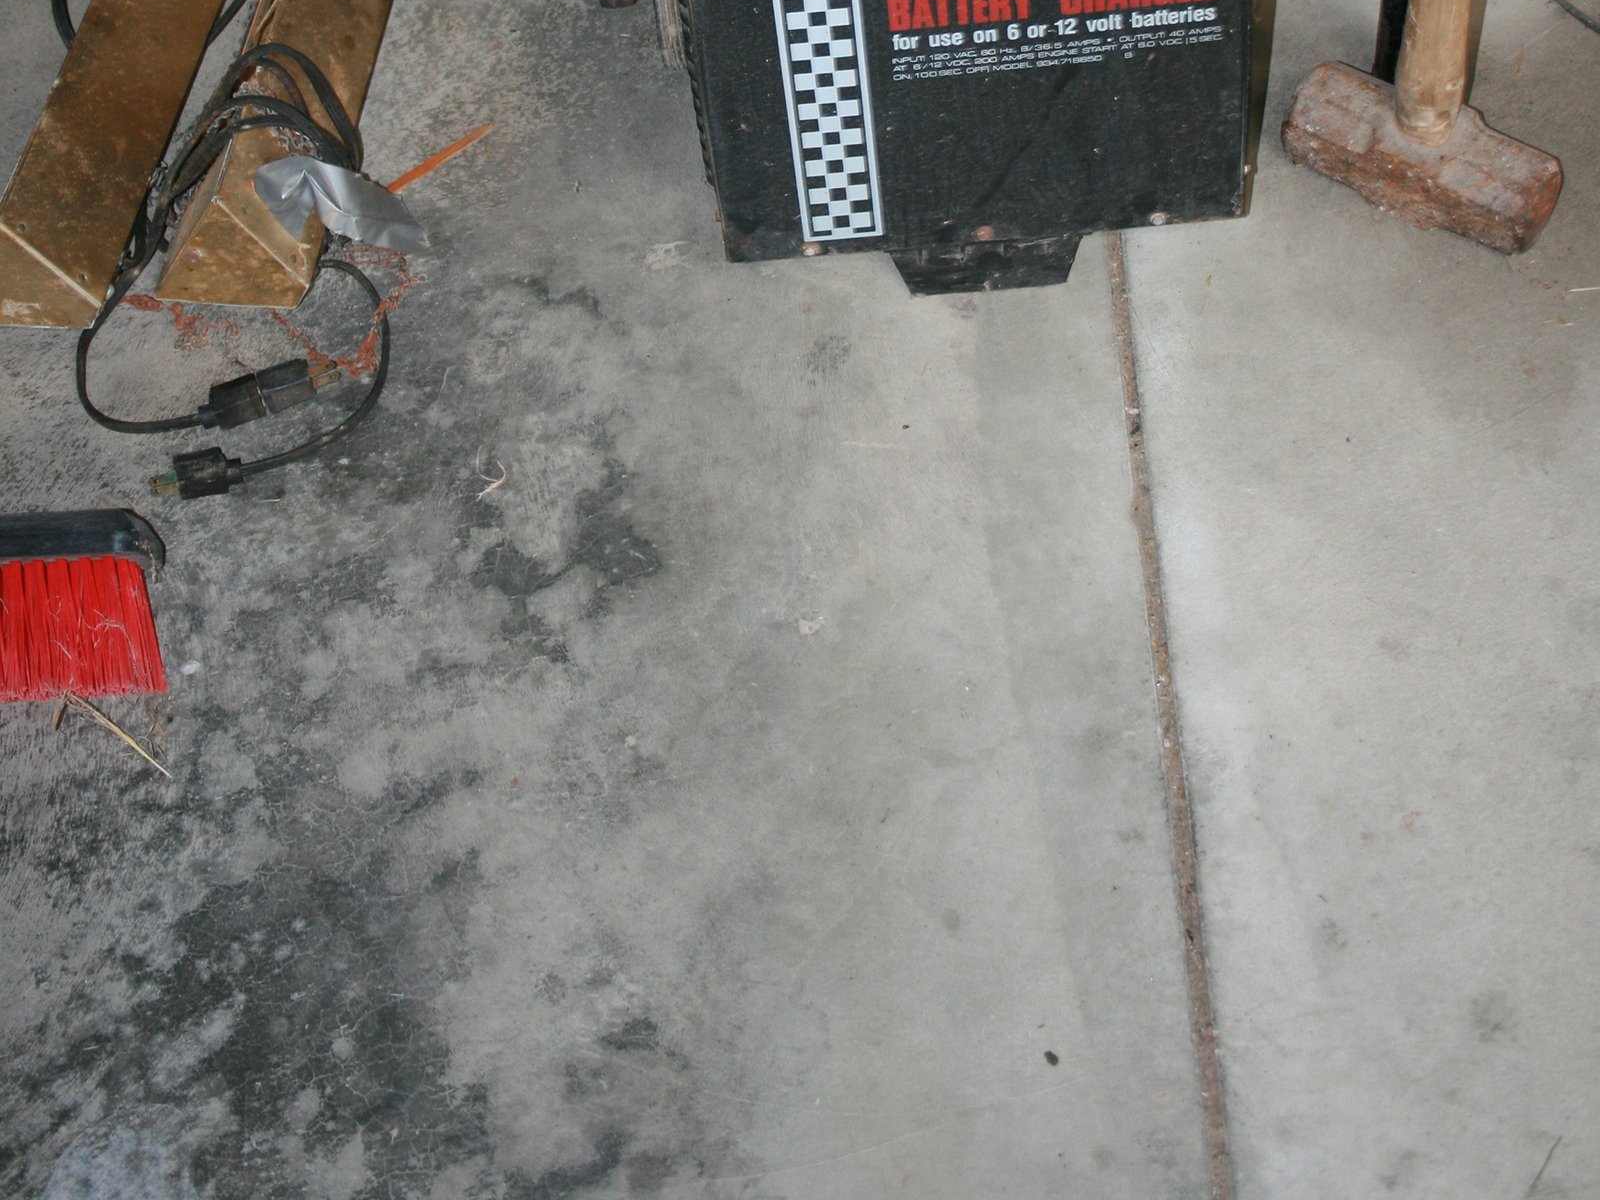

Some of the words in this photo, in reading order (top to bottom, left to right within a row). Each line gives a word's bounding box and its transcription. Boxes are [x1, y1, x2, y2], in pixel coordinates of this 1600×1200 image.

[892, 33, 919, 51] for
[929, 31, 963, 48] use
[973, 29, 998, 44] on
[1007, 23, 1021, 40] 6
[1027, 23, 1048, 39] or
[1054, 17, 1078, 36] 12
[1086, 14, 1123, 33] volt
[1131, 6, 1217, 30] batteries
[929, 53, 950, 61] 120
[981, 48, 996, 56] 60
[1067, 37, 1101, 48] AMPS
[1169, 29, 1185, 38] 40
[1188, 25, 1222, 36] AMPS
[974, 56, 998, 65] 200
[1001, 52, 1035, 62] AMPS
[1038, 48, 1079, 59] ENGINE
[1082, 44, 1116, 54] START
[1120, 42, 1134, 51] AT
[1158, 37, 1183, 46] VDC
[966, 64, 989, 74] OFF)
[993, 61, 1034, 72] MODEL
